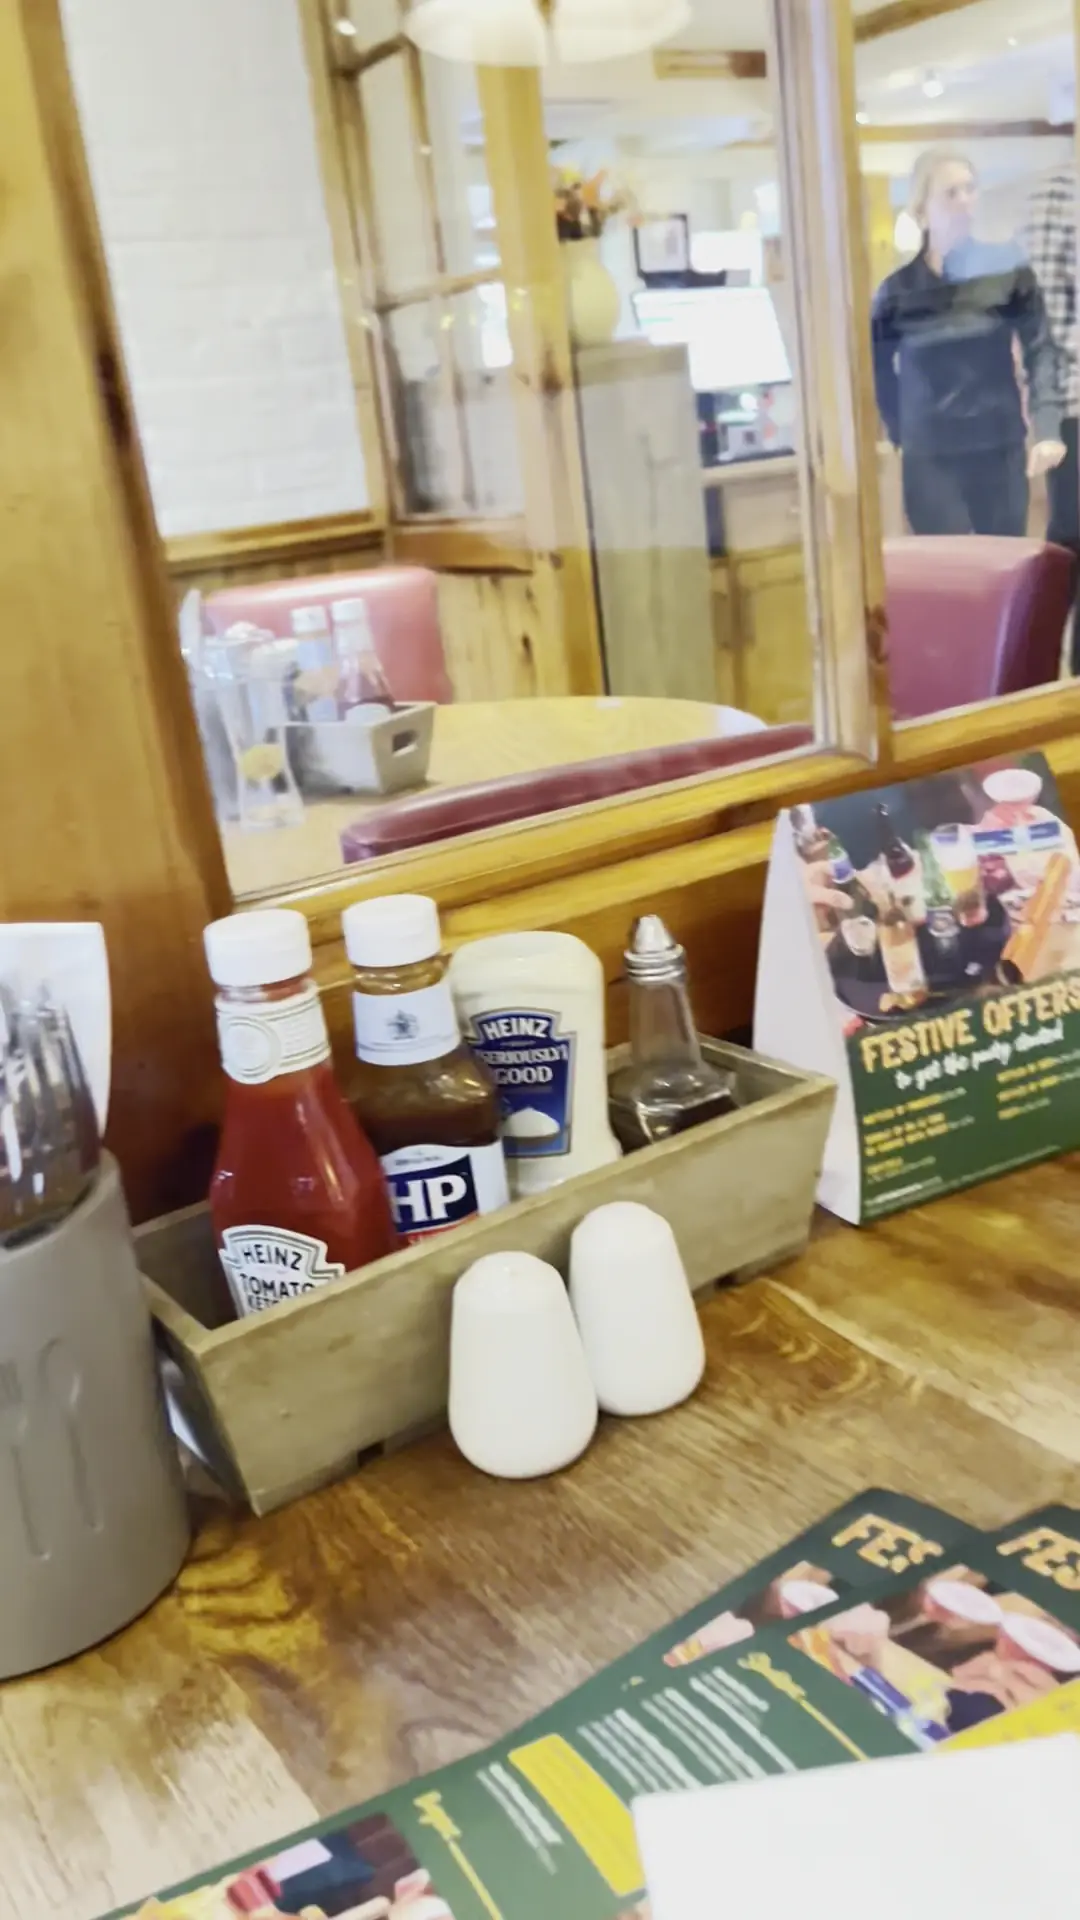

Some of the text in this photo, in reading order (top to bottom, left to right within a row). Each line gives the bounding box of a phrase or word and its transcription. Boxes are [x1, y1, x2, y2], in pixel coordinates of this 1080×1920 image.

[483, 1017, 550, 1041] HEINZ
[861, 1009, 977, 1074] FESTIVE
[983, 976, 1080, 1036] OFFERS
[495, 1066, 554, 1085] GOOD
[388, 1174, 467, 1223] HP
[242, 1243, 303, 1271] HEINZ
